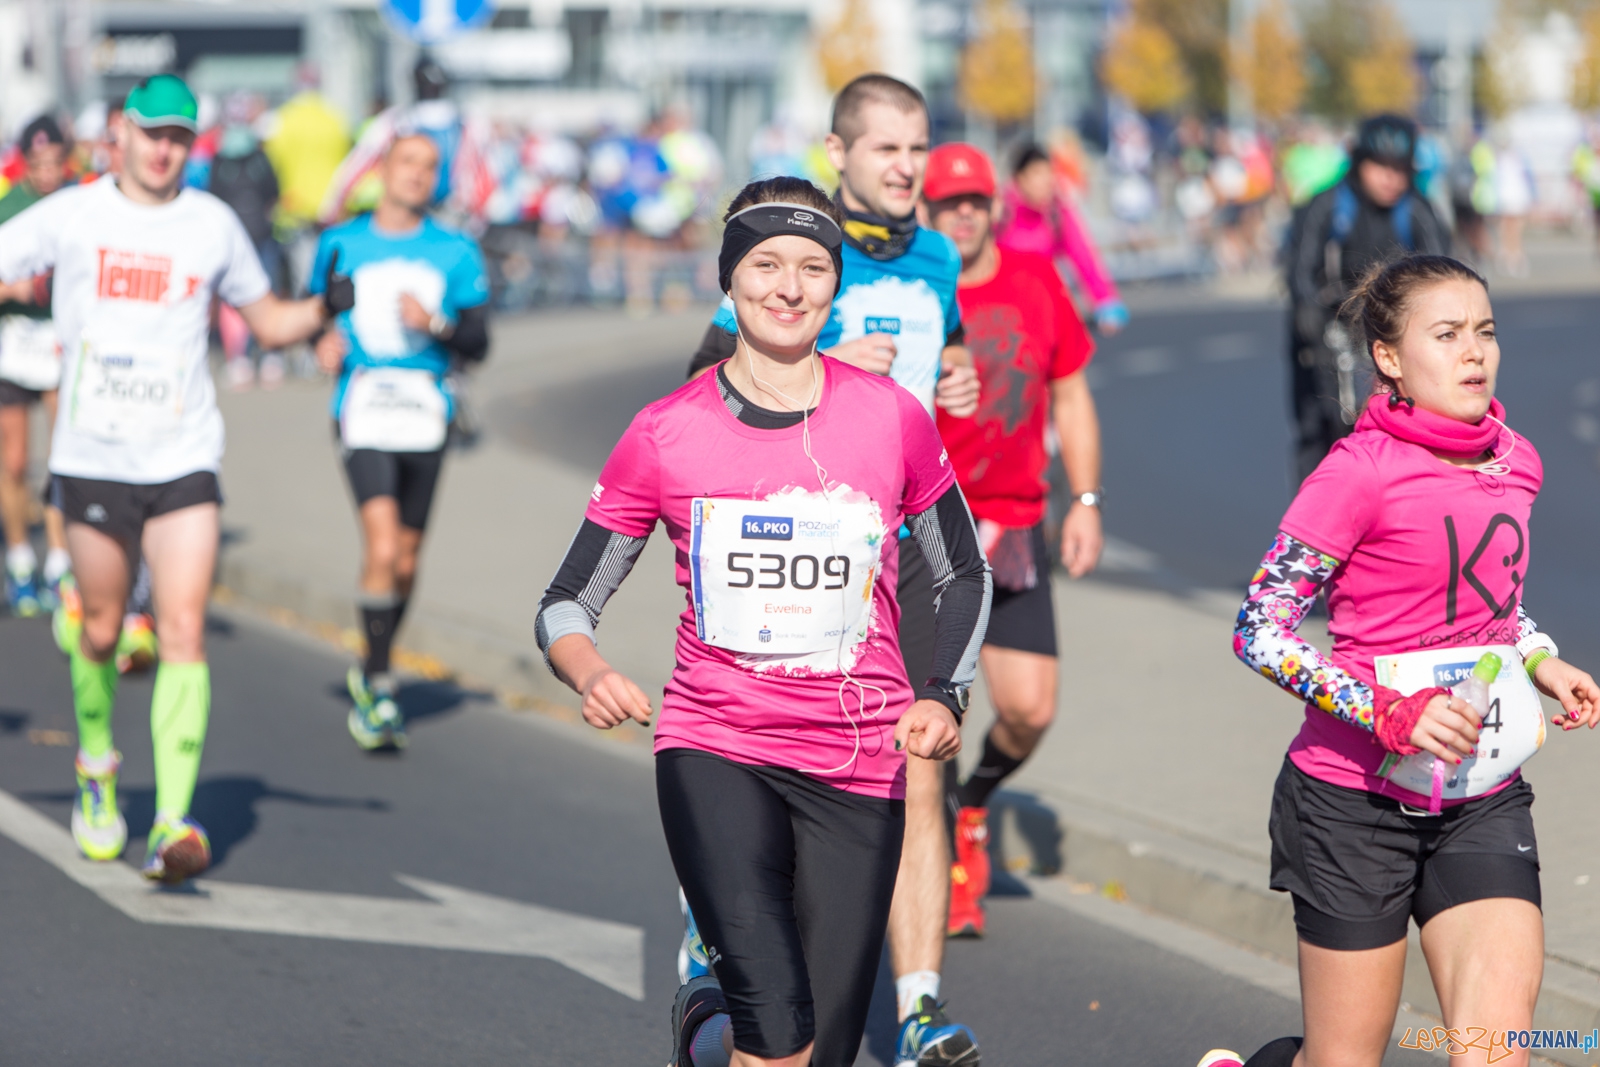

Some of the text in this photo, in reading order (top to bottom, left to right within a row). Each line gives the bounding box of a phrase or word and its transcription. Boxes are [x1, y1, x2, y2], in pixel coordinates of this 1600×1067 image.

[745, 521, 762, 534] 16.
[763, 522, 790, 535] PKO
[727, 552, 850, 591] 5309
[764, 602, 813, 615] Ewelina
[1437, 669, 1455, 682] 16.
